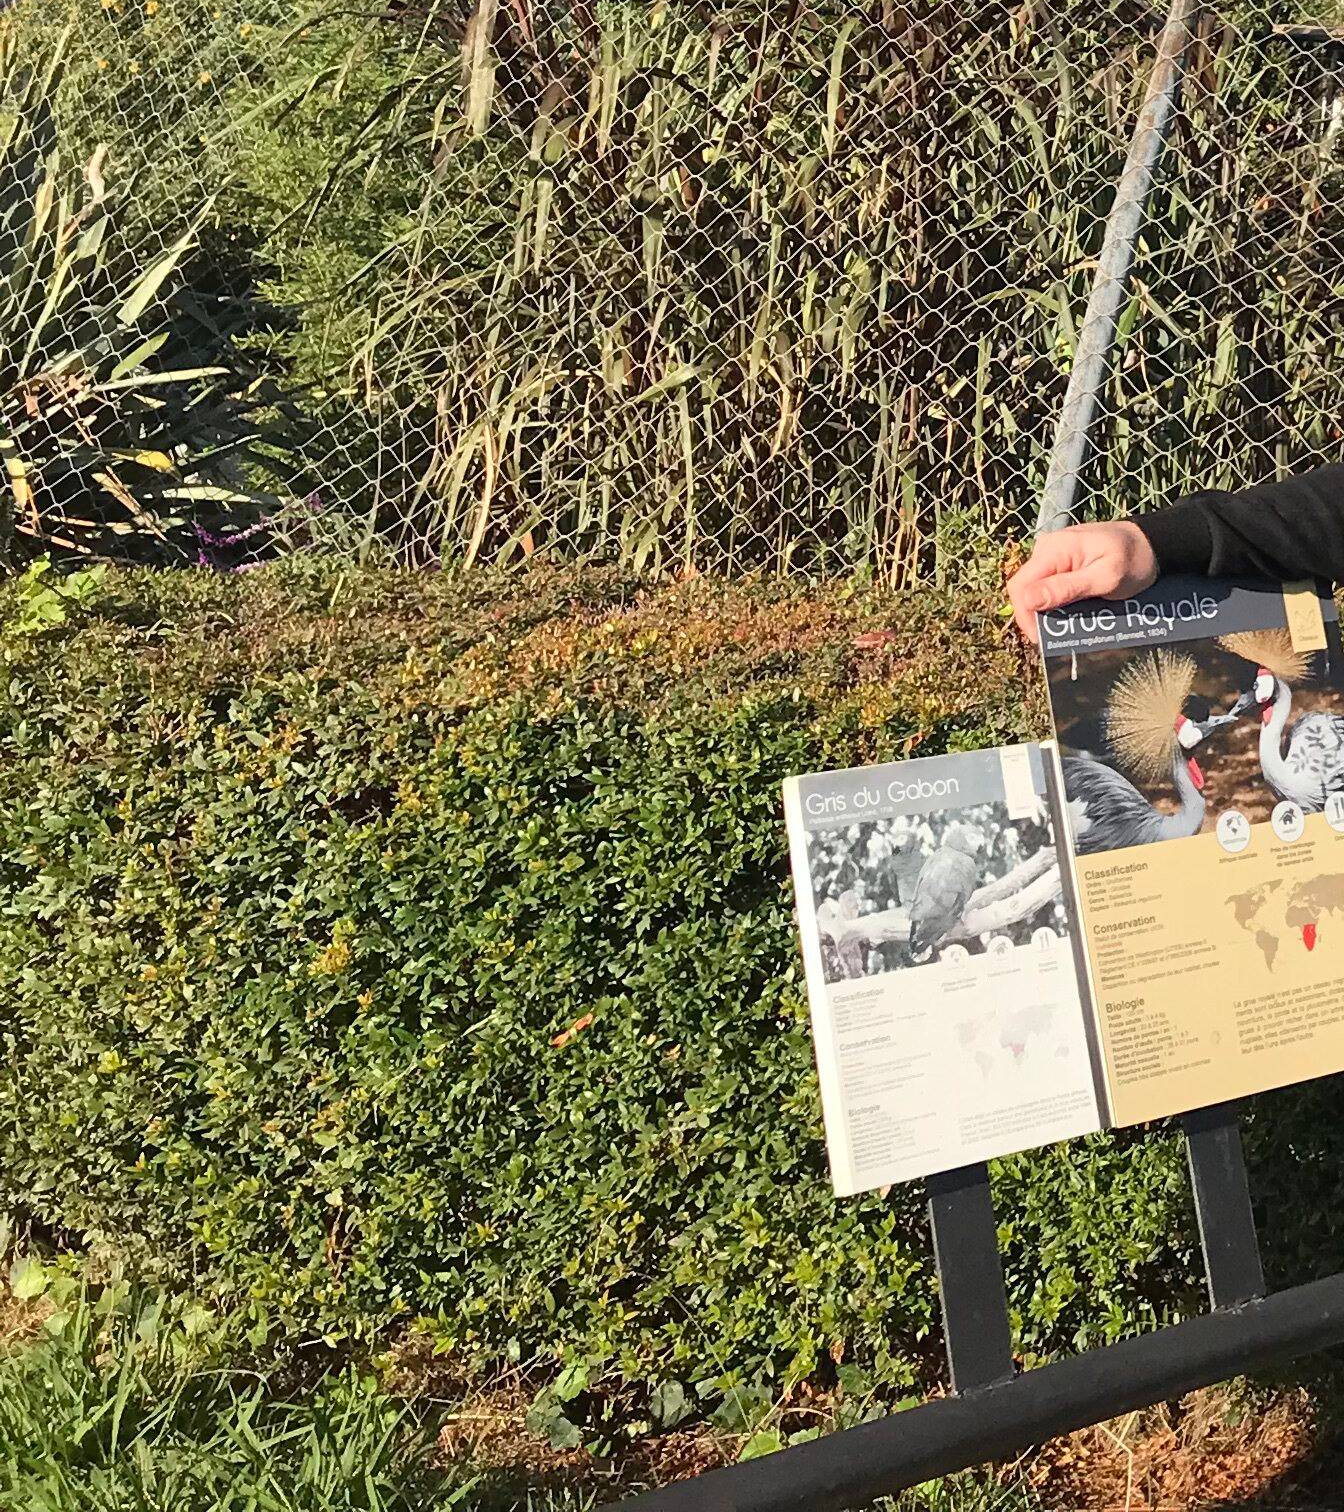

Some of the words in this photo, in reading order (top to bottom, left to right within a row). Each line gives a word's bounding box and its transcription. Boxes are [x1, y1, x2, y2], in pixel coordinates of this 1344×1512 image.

[1043, 609, 1116, 637] Grue
[1124, 592, 1218, 630] Royale
[805, 792, 846, 815] Gris
[853, 786, 881, 808] du
[887, 777, 960, 803] Gabon
[1084, 862, 1148, 880] Classification
[1093, 915, 1156, 934] Conservation
[1105, 996, 1145, 1013] Biologie
